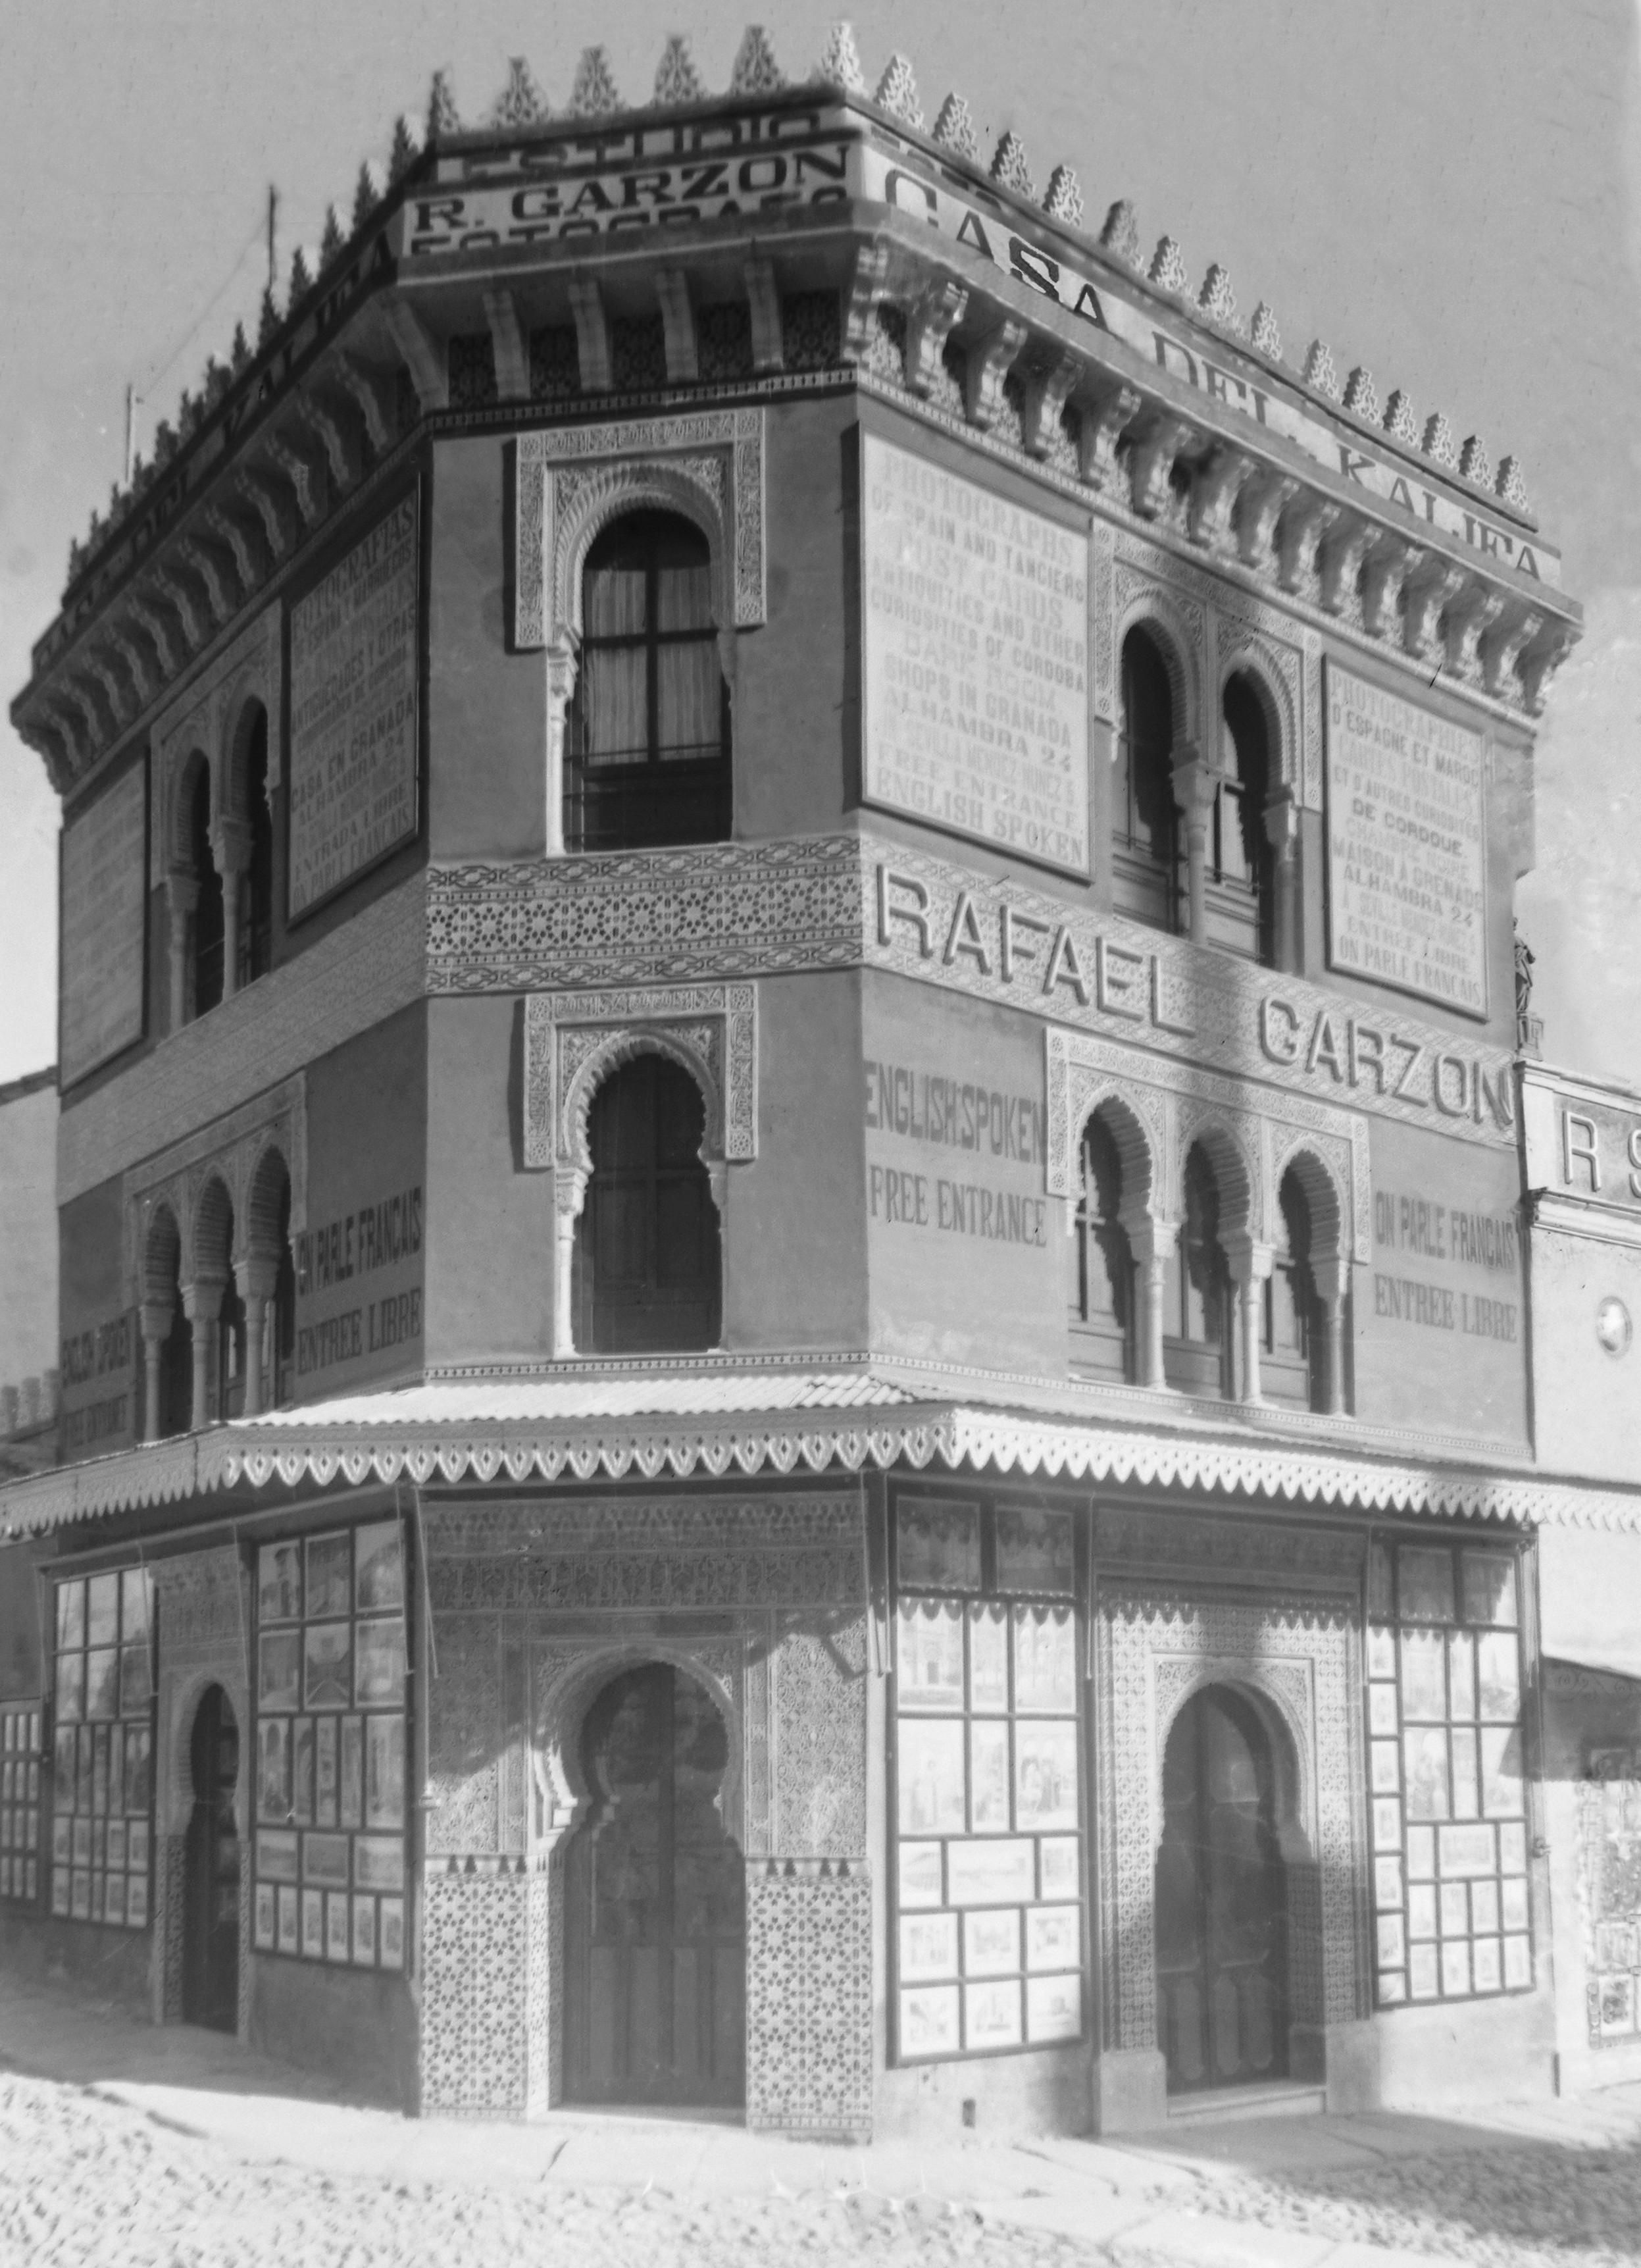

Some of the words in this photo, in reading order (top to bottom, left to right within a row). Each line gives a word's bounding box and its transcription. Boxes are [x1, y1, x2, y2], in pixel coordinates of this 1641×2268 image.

[414, 198, 484, 232] R.
[511, 144, 850, 220] GARZON
[885, 168, 1109, 331] CASA
[1152, 330, 1296, 442] DEL
[1336, 442, 1540, 581] KALIFA
[872, 483, 893, 518] OF
[964, 526, 996, 563] AND
[1004, 543, 1085, 605] TANGIERS
[884, 448, 1073, 569] PHOTOGRAPHS
[985, 633, 1004, 663] OF
[1012, 644, 1084, 695] CORDOBA
[992, 606, 1024, 642] AND
[1032, 621, 1084, 668] OTHER
[884, 650, 950, 703] SHOPS
[959, 679, 976, 713] IN
[986, 690, 1071, 750] GRANADA
[884, 682, 1028, 758] ALHAMBRA
[291, 766, 322, 814] CASA
[351, 688, 414, 764] GRANADA
[299, 747, 377, 830] ALHAMBRA
[878, 740, 939, 782] FREE
[953, 767, 1078, 832] ENTRANCE
[1413, 739, 1429, 767] ET
[876, 764, 984, 831] ENGLISH
[994, 806, 1083, 867] SPOKEN
[1352, 796, 1375, 823] DE
[1344, 862, 1442, 916] ALHAMBRA
[876, 863, 1196, 1038] RAFAEL
[1259, 994, 1514, 1127] GARZON
[1340, 933, 1358, 964] ON
[1364, 941, 1409, 981] PARLE
[961, 1083, 1045, 1166] SPOKEN
[870, 1164, 928, 1226] FREE
[937, 1179, 1048, 1249] ENTRANCE
[1376, 1191, 1395, 1249] ON
[1400, 1196, 1446, 1260] PARLE
[317, 1216, 353, 1289] PARLE
[297, 1308, 363, 1376] ENTREE
[368, 1287, 422, 1354] LIBRE
[1374, 1274, 1455, 1331] ENTREE
[1461, 1293, 1518, 1343] LIBRE
